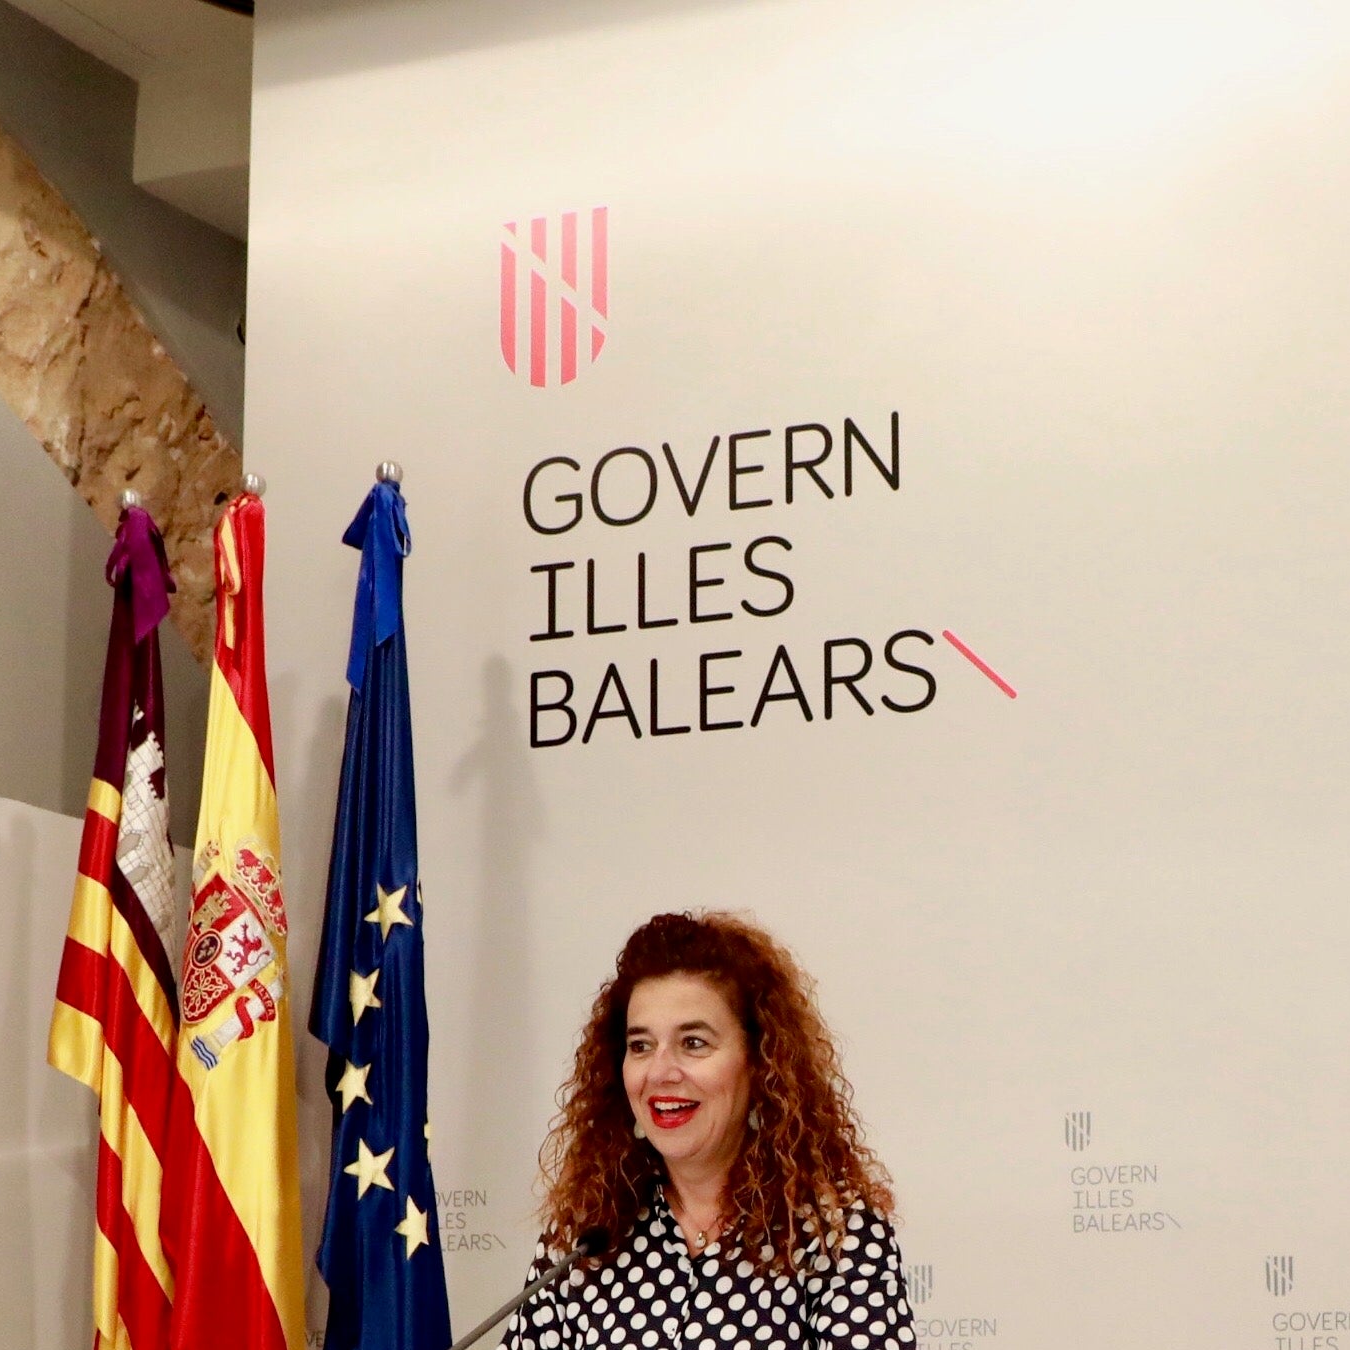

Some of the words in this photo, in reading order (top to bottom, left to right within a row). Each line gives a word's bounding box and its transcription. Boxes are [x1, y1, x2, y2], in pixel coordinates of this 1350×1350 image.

[523, 410, 900, 535] GOVERN
[529, 535, 794, 642] ILLES
[529, 629, 937, 748] BALEARS
[1070, 1164, 1158, 1186] GOVERN
[435, 1190, 487, 1207] VERN
[1072, 1188, 1134, 1210] ILLES
[1072, 1210, 1166, 1234] BALEARS
[442, 1233, 492, 1252] EARS
[915, 1318, 997, 1338] GOVERN
